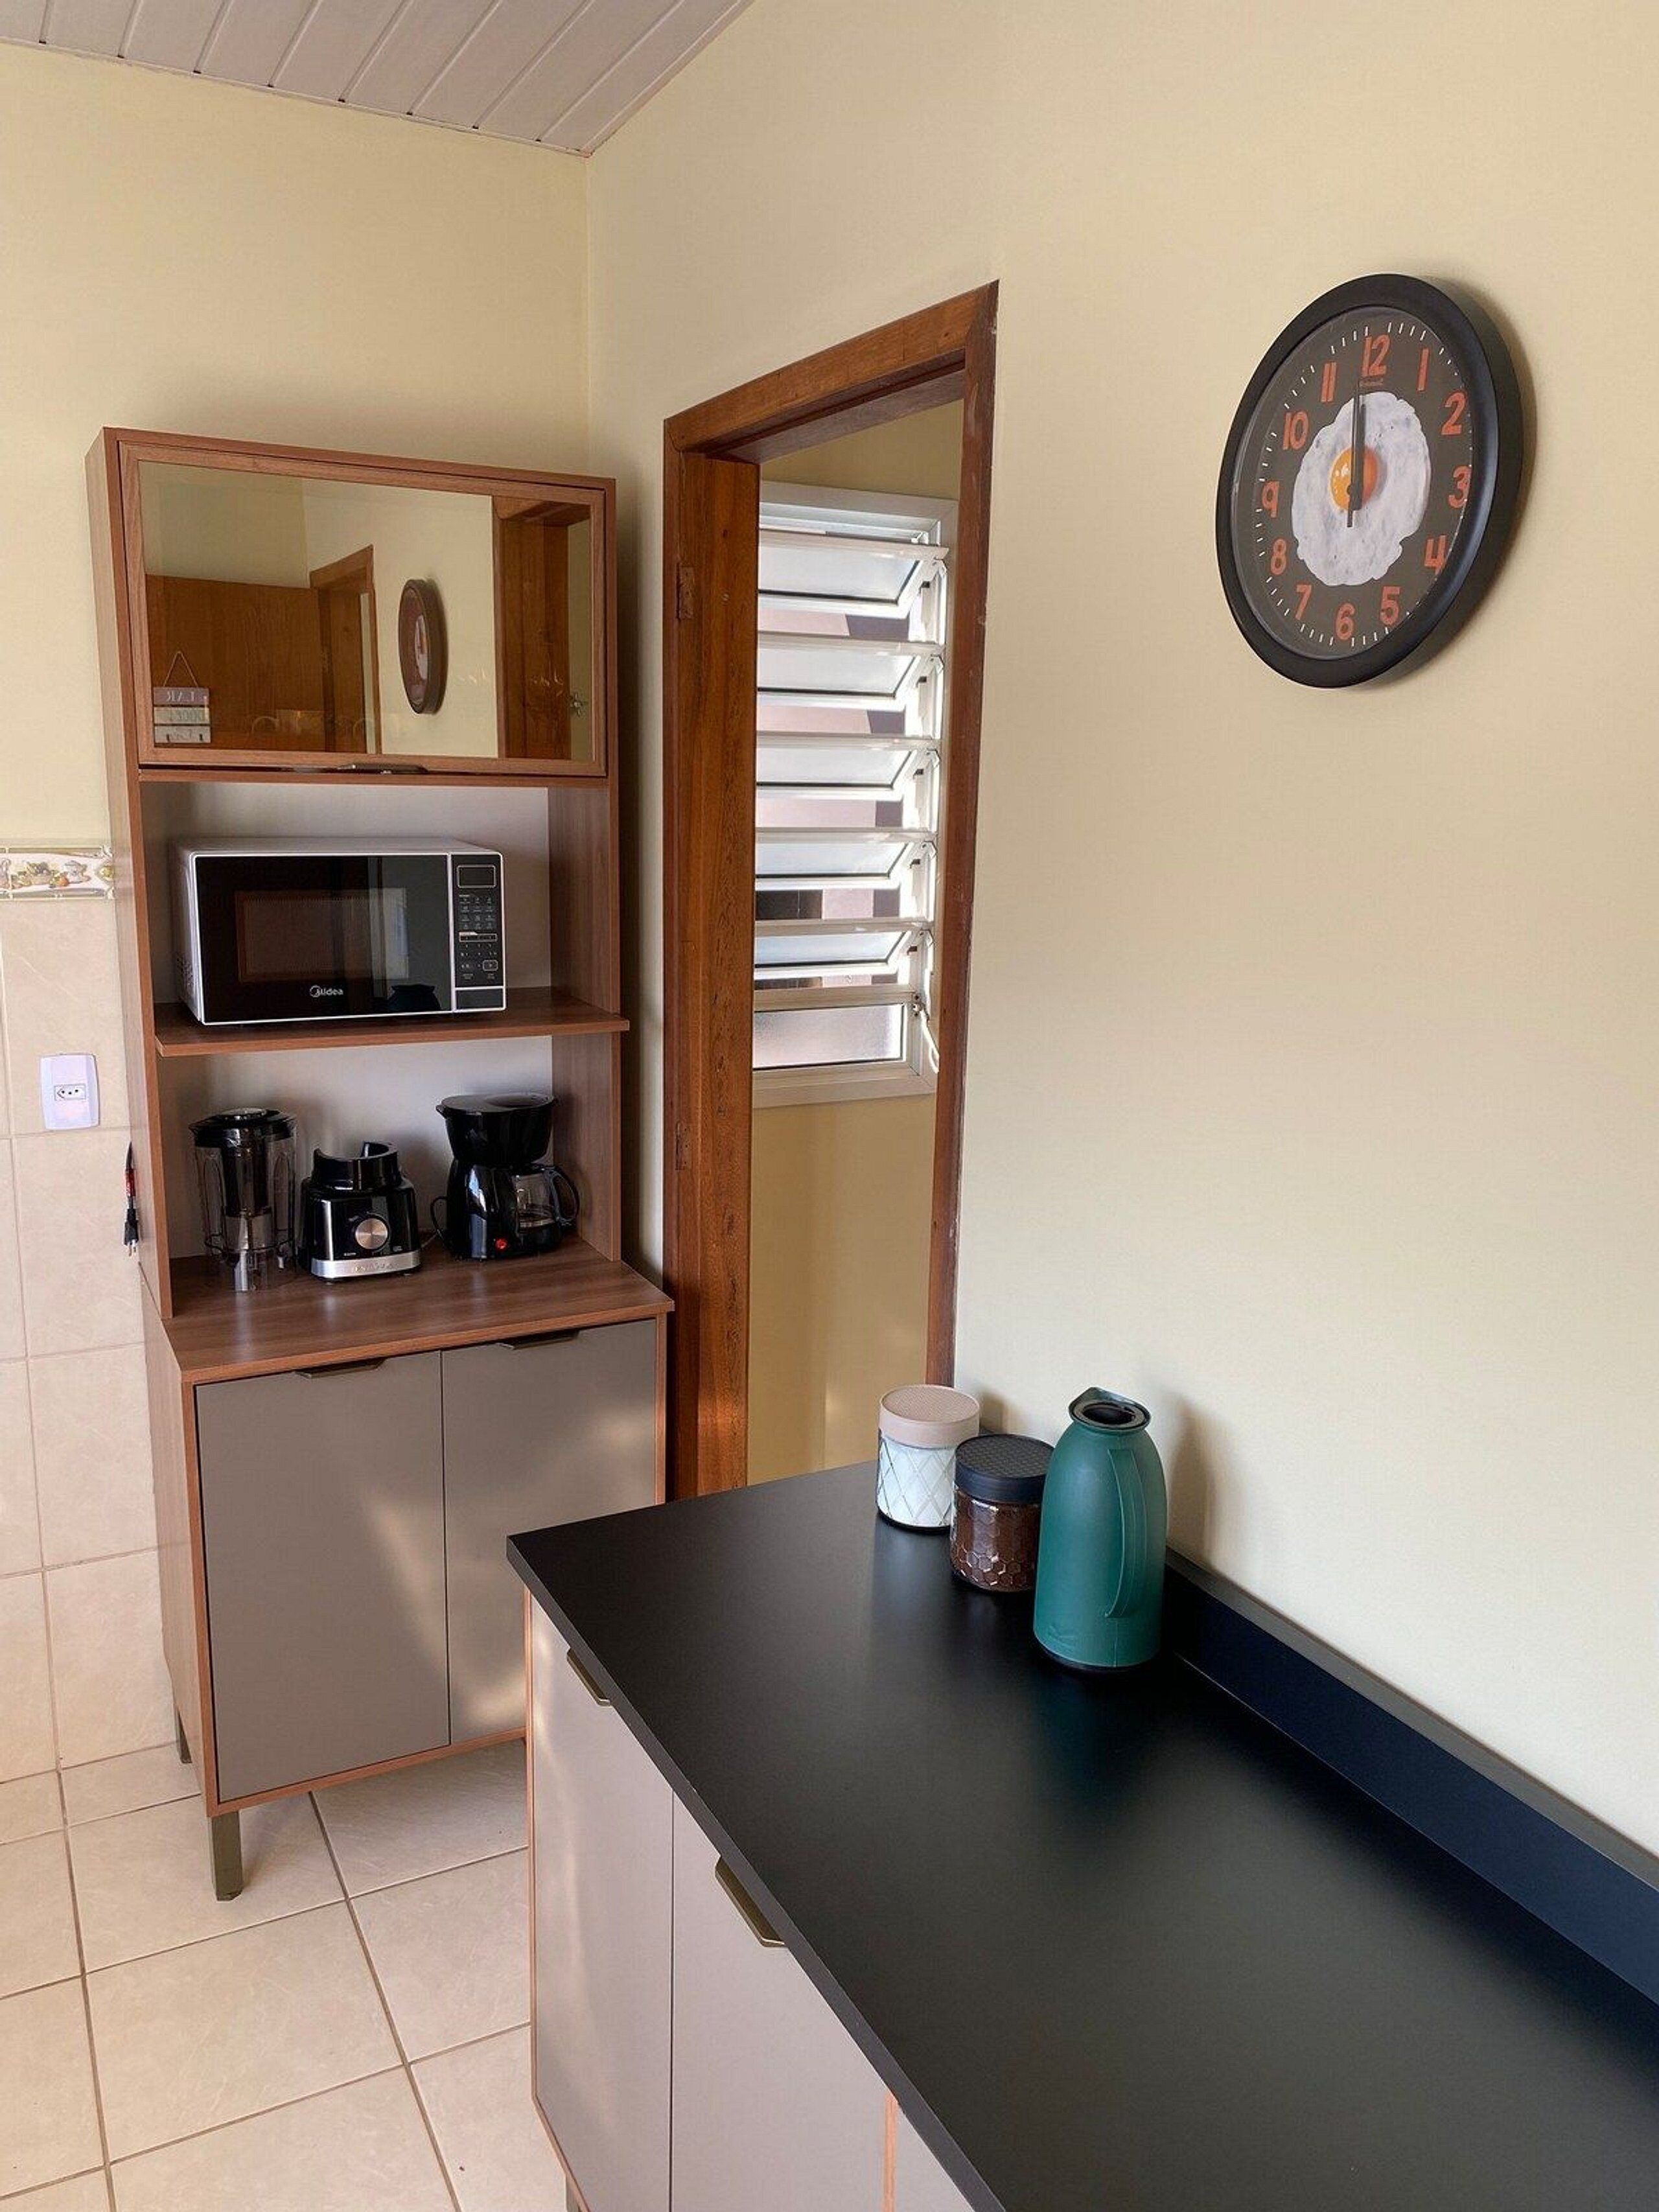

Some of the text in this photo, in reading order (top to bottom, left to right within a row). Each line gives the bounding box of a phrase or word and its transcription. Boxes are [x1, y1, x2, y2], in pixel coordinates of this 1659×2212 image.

[1363, 335, 1390, 377] 12
[1418, 349, 1429, 391] 1
[1321, 362, 1337, 402] 11
[1282, 411, 1309, 450] 10
[1441, 393, 1467, 435] 2
[1262, 481, 1281, 517] 9
[1448, 466, 1471, 508] 3
[1270, 539, 1288, 576] 8
[1424, 535, 1447, 576] 4
[1296, 585, 1312, 620] 7
[1335, 603, 1355, 640] 6
[1380, 587, 1400, 625] 5
[310, 984, 343, 997] Midea
